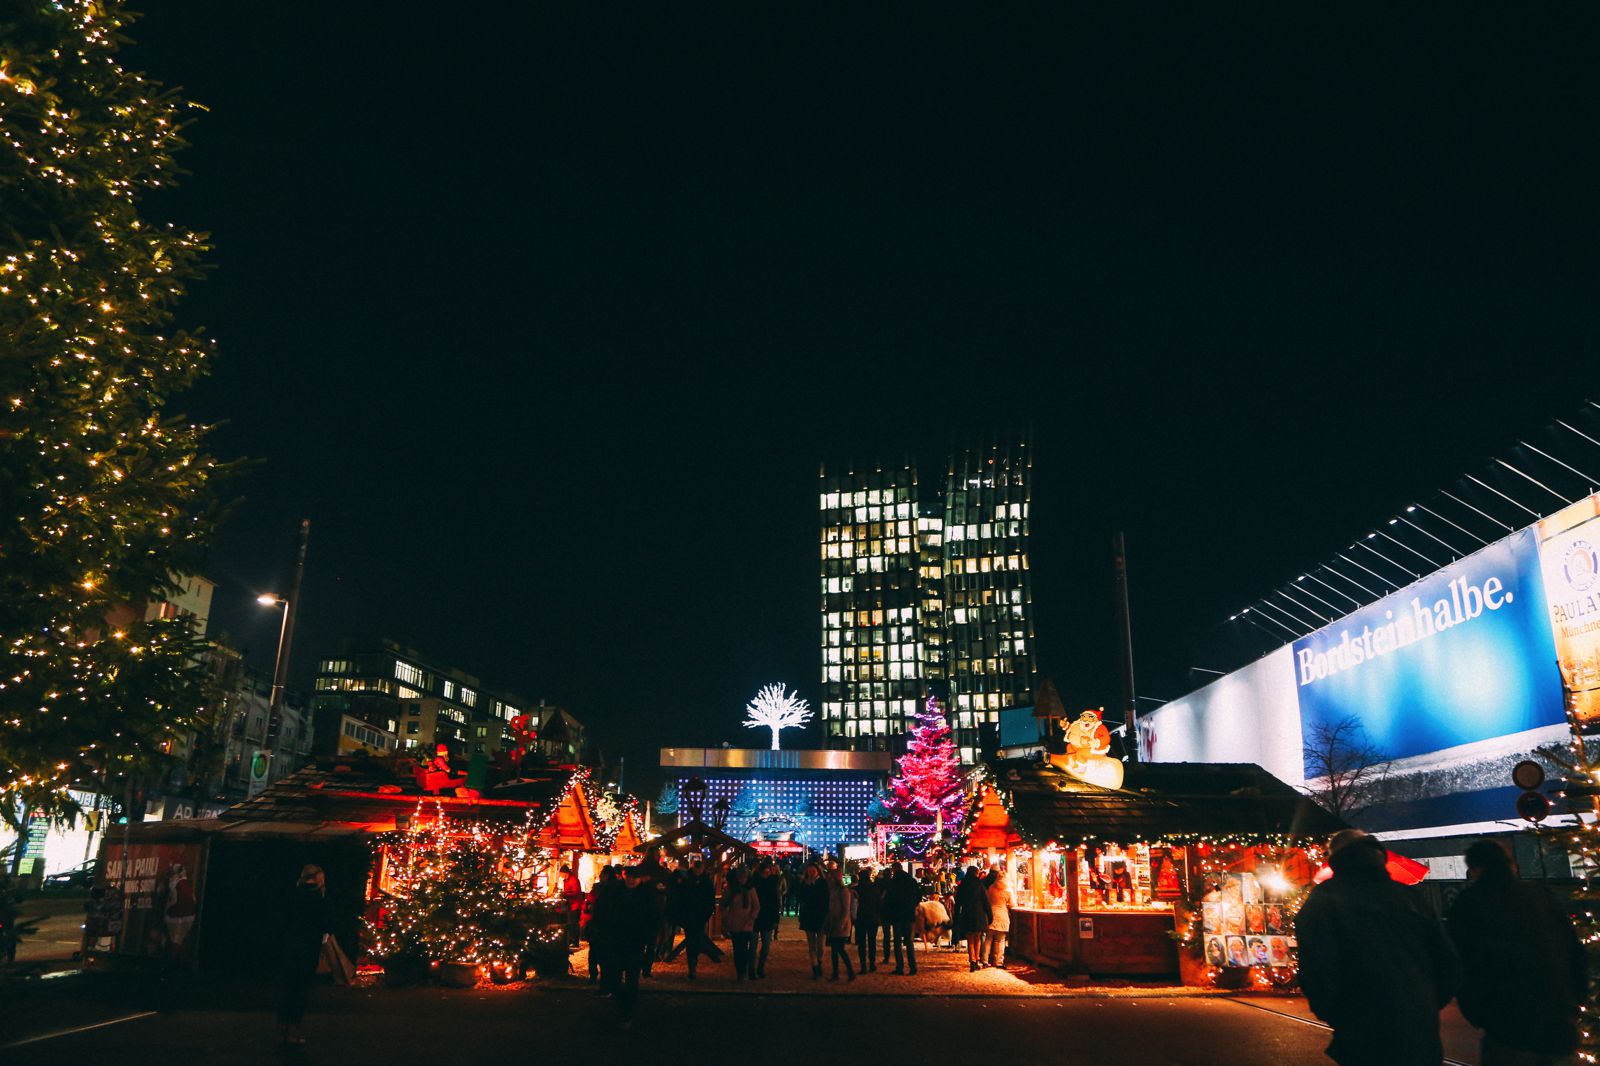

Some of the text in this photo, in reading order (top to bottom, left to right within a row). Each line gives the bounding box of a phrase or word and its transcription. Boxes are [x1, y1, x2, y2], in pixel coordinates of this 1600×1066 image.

[1553, 592, 1600, 623] PAULA
[1297, 575, 1514, 687] Bordsteinhalbe.
[104, 857, 160, 879] SANA PAULI
